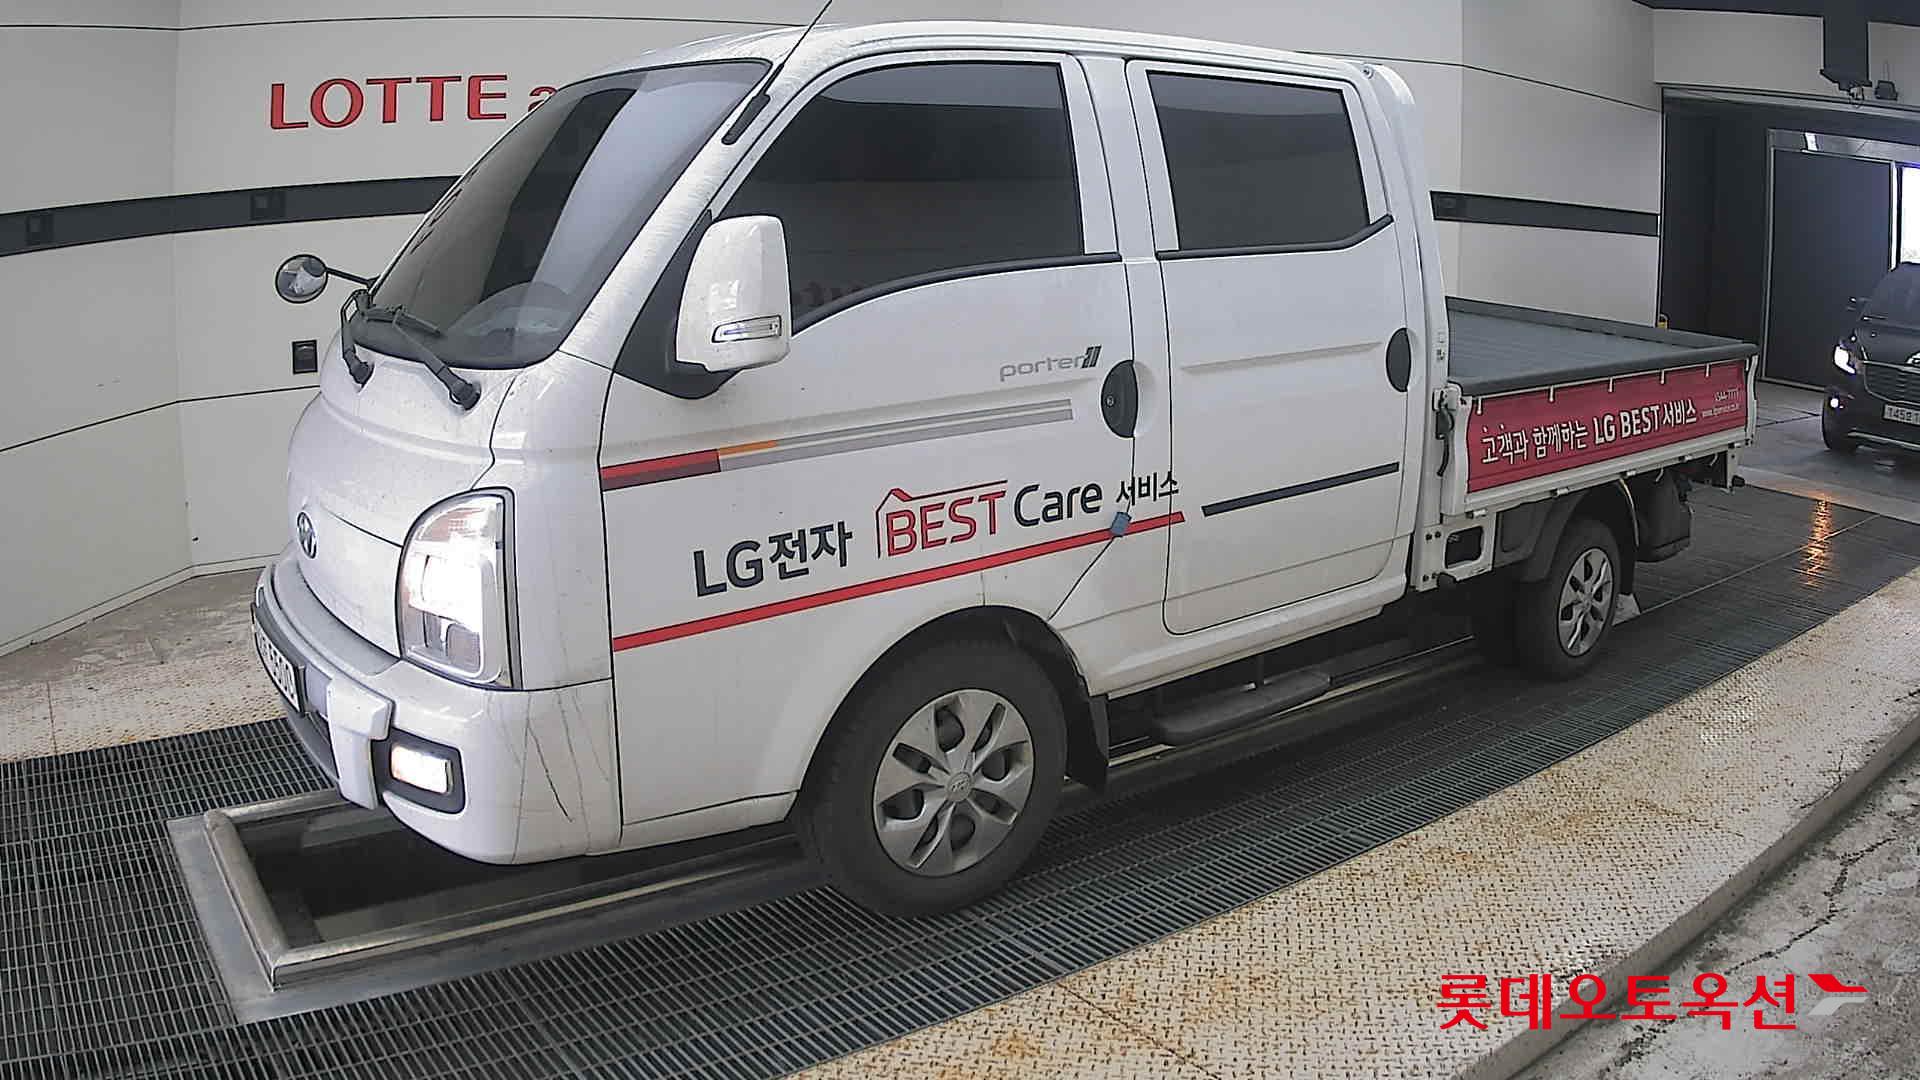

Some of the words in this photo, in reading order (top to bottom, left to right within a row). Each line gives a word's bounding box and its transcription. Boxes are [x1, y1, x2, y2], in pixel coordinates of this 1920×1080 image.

[269, 75, 508, 130] LOTTE
[1482, 428, 1529, 465] 고객과
[1532, 420, 1588, 459] 함께하는
[1593, 415, 1616, 445] LG
[1620, 404, 1660, 439] BEST
[1663, 398, 1697, 427] 서비스
[693, 520, 853, 597] LG전자
[885, 490, 1007, 558] BEST
[1013, 482, 1103, 527] Care
[1115, 470, 1180, 507] 서비스
